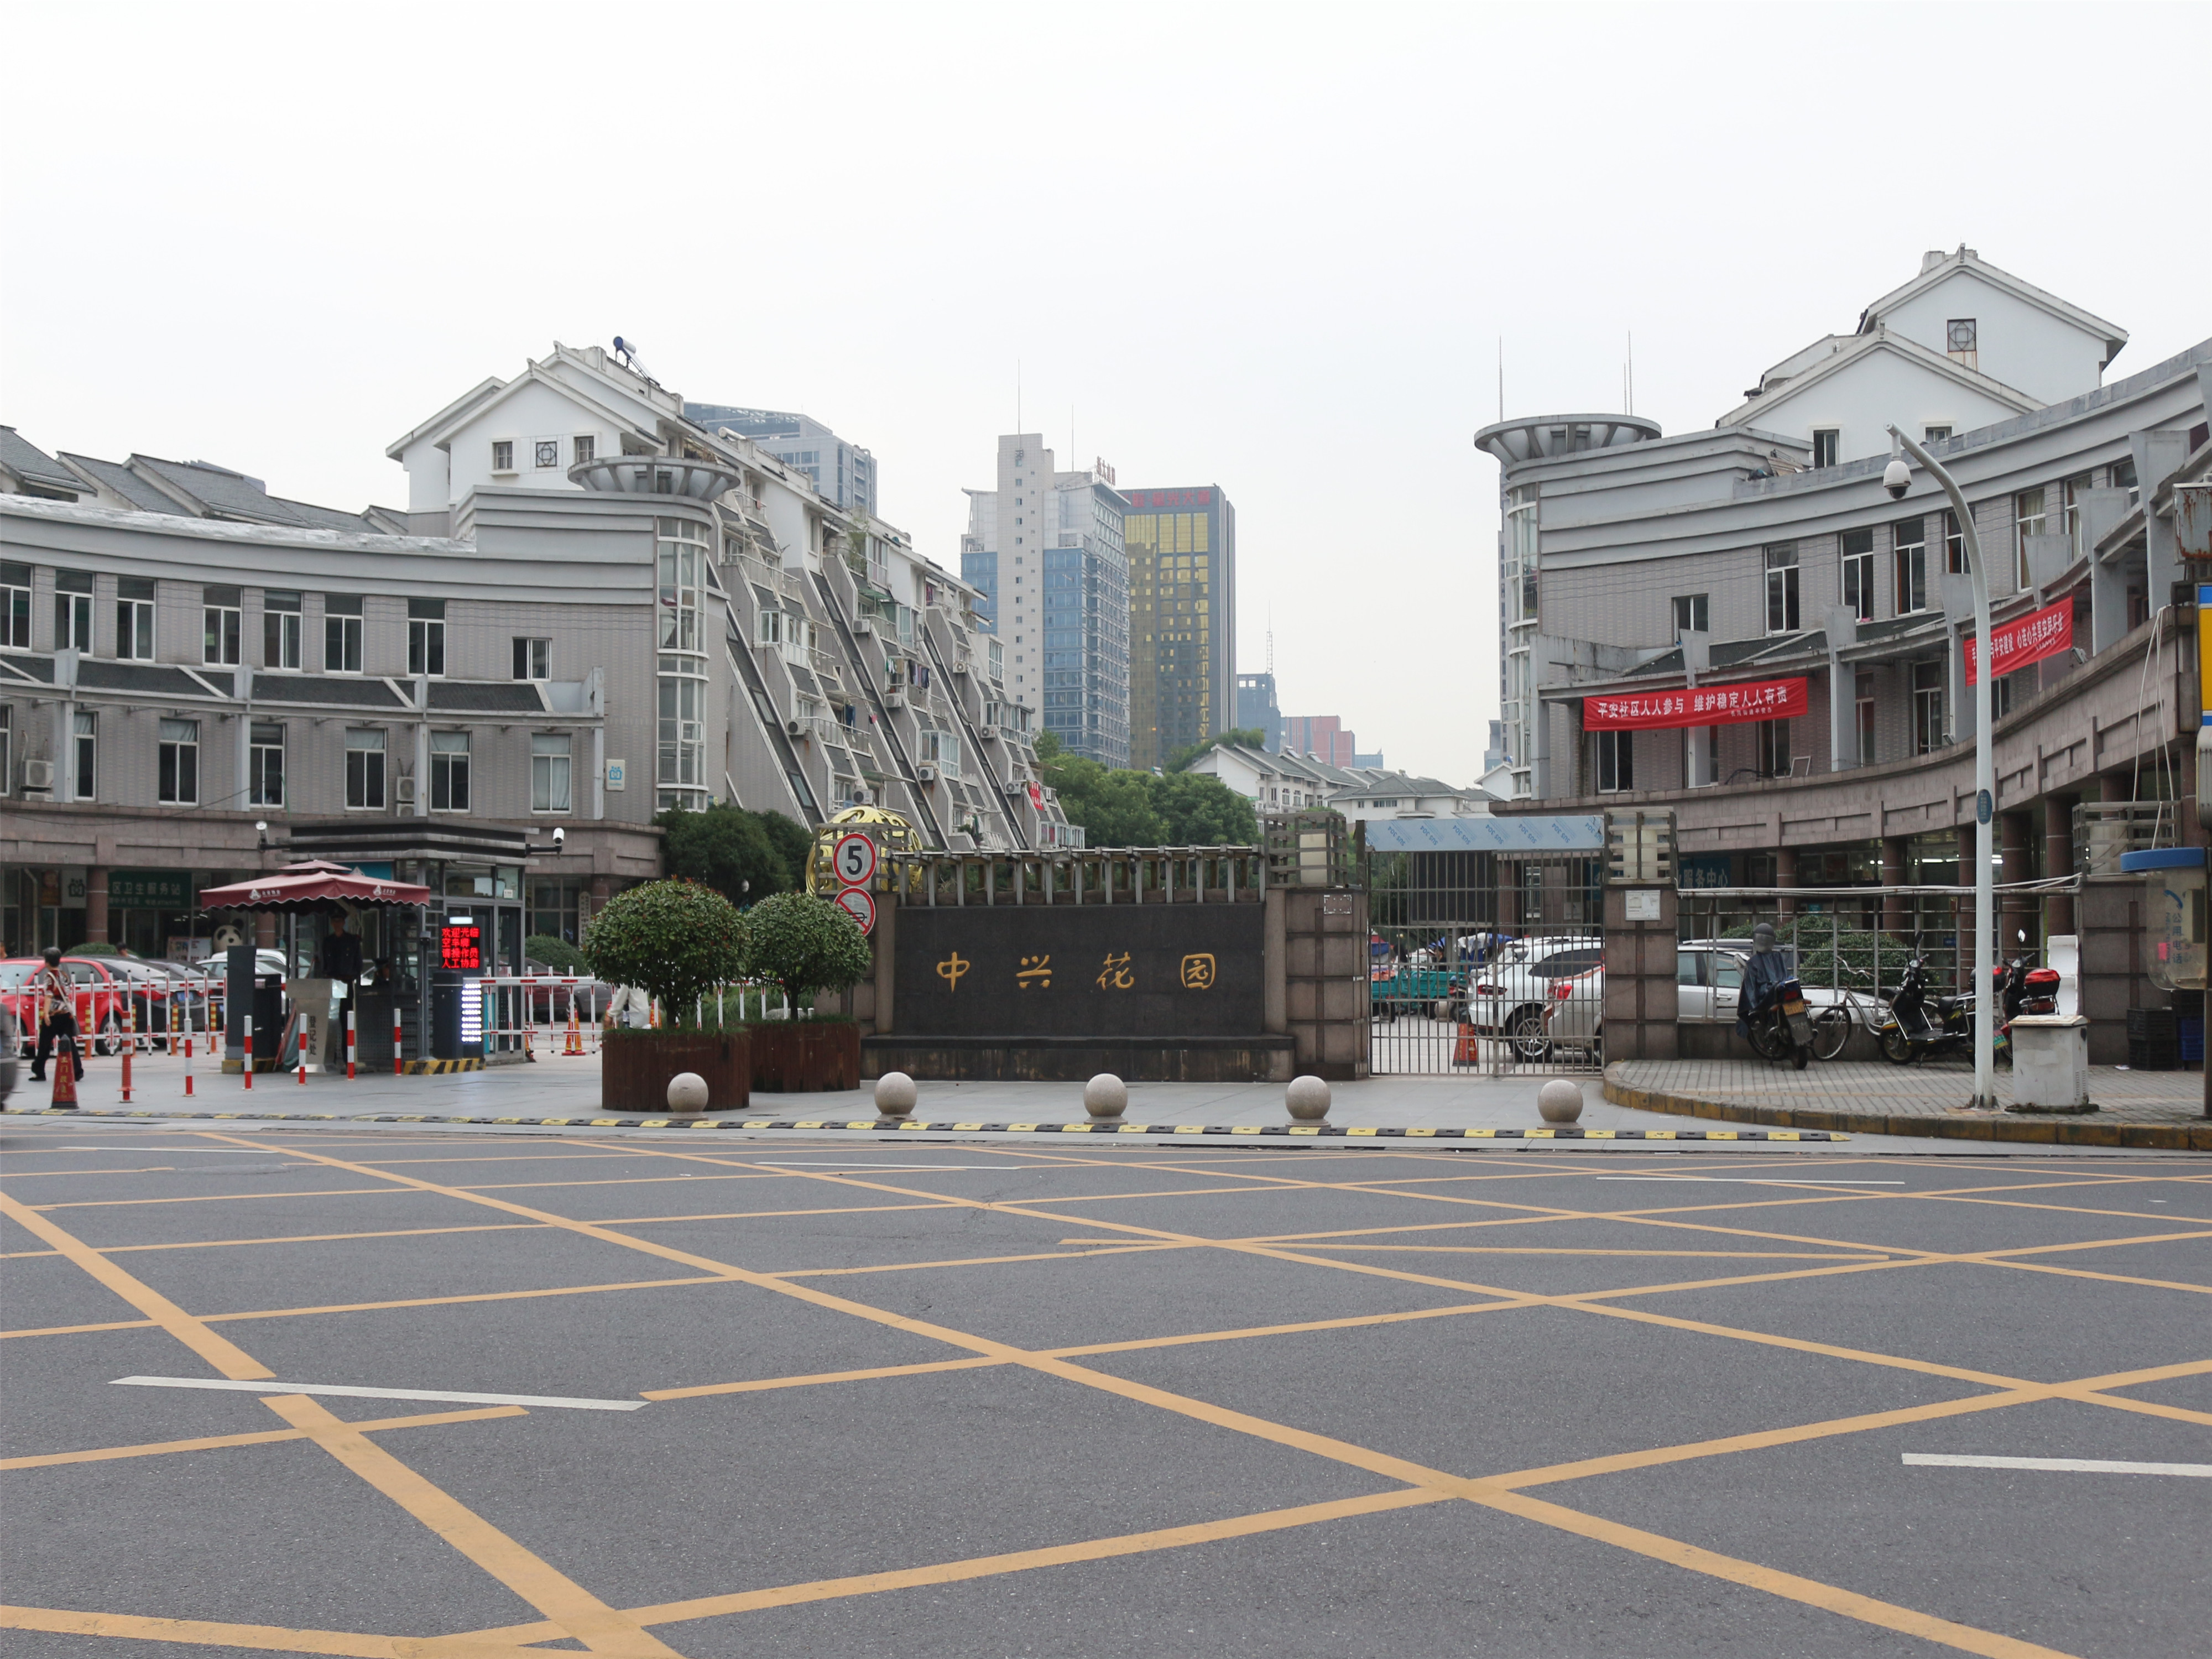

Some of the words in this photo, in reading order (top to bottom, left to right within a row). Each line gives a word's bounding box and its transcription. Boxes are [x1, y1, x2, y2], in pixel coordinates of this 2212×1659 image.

[1121, 490, 1210, 508] 联·星光大道
[1971, 633, 2014, 666] 手与平安建设
[1598, 697, 1684, 718] 平安社区人人参与
[1693, 686, 1788, 712] 维护稳定人人有责
[1387, 826, 1397, 837] 304
[1420, 825, 1430, 837] 304
[1453, 825, 1463, 836] 304
[1485, 824, 1495, 836] 304
[1519, 823, 1528, 834] 304
[1552, 823, 1562, 834] 304
[1585, 822, 1595, 833] 304
[1396, 836, 1406, 846] SUS
[1429, 835, 1438, 846] SUS
[1462, 834, 1471, 845] SUS
[1494, 834, 1504, 844] SUS
[1528, 833, 1537, 844] SUS
[1561, 833, 1571, 843] SUS
[846, 845, 863, 875] 5
[1679, 867, 1729, 888] 服务中心
[441, 927, 480, 938] 欢迎光临
[2172, 912, 2183, 964] 公用电话
[441, 947, 479, 958] 请操作员
[441, 958, 480, 969] 人工协助
[936, 951, 1217, 993] 中兴花园
